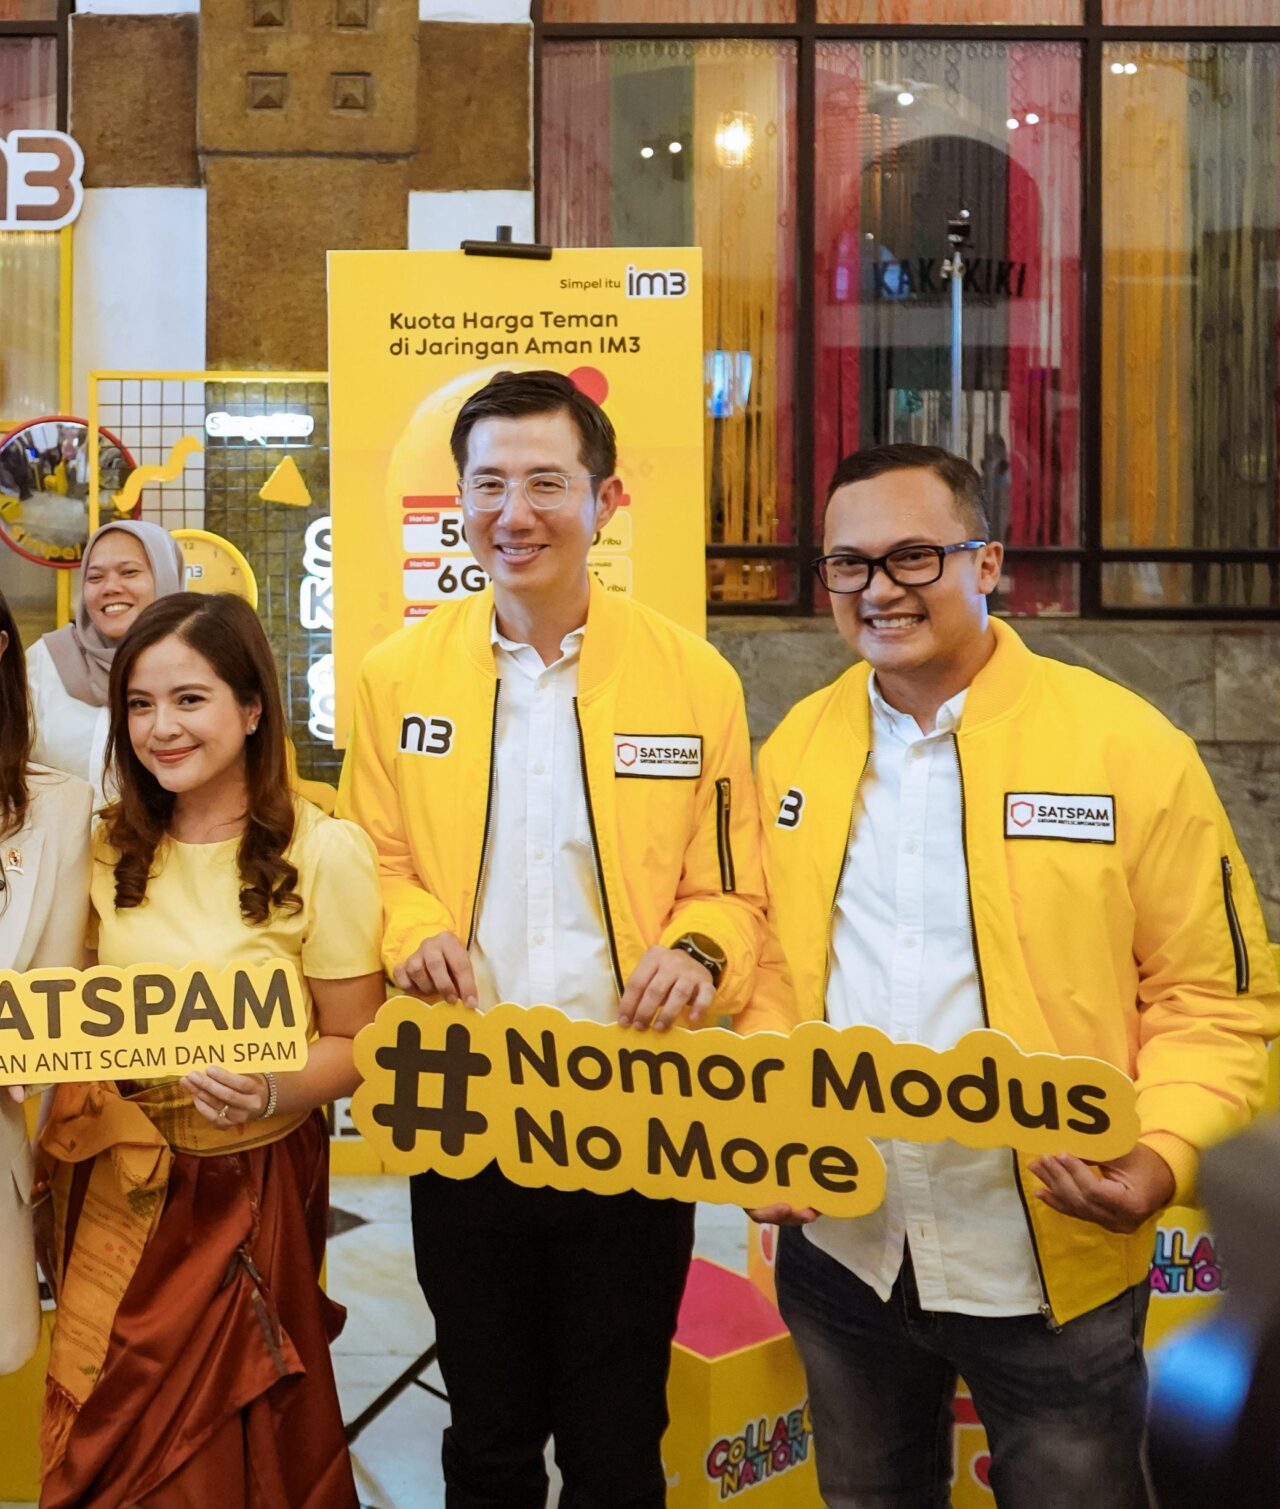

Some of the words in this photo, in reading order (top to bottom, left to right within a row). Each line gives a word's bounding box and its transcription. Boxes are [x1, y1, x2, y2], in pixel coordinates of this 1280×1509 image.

[560, 278, 602, 291] Simpel
[605, 278, 621, 289] itu
[628, 266, 687, 296] im3
[872, 257, 1027, 297] KAKKIKI
[390, 313, 455, 329] Kuota
[463, 312, 533, 333] Harga
[540, 311, 618, 328] Teman
[390, 337, 409, 355] di
[415, 337, 518, 360] Jaringan
[525, 337, 592, 354] Aman
[600, 336, 640, 353] IM3
[438, 565, 492, 593] 6G
[607, 584, 626, 592] ribu
[640, 747, 698, 759] SATSPAM
[1038, 806, 1109, 821] SATSPAM
[35, 1050, 91, 1073] ANTI
[100, 1046, 166, 1070] SCAM
[176, 1044, 226, 1067] DAN
[233, 1041, 297, 1063] SPAM
[504, 1027, 785, 1104] Nomor
[811, 1046, 1111, 1135] Modus
[515, 1106, 622, 1171] No
[647, 1117, 859, 1194] More
[721, 1434, 808, 1498] NATION
